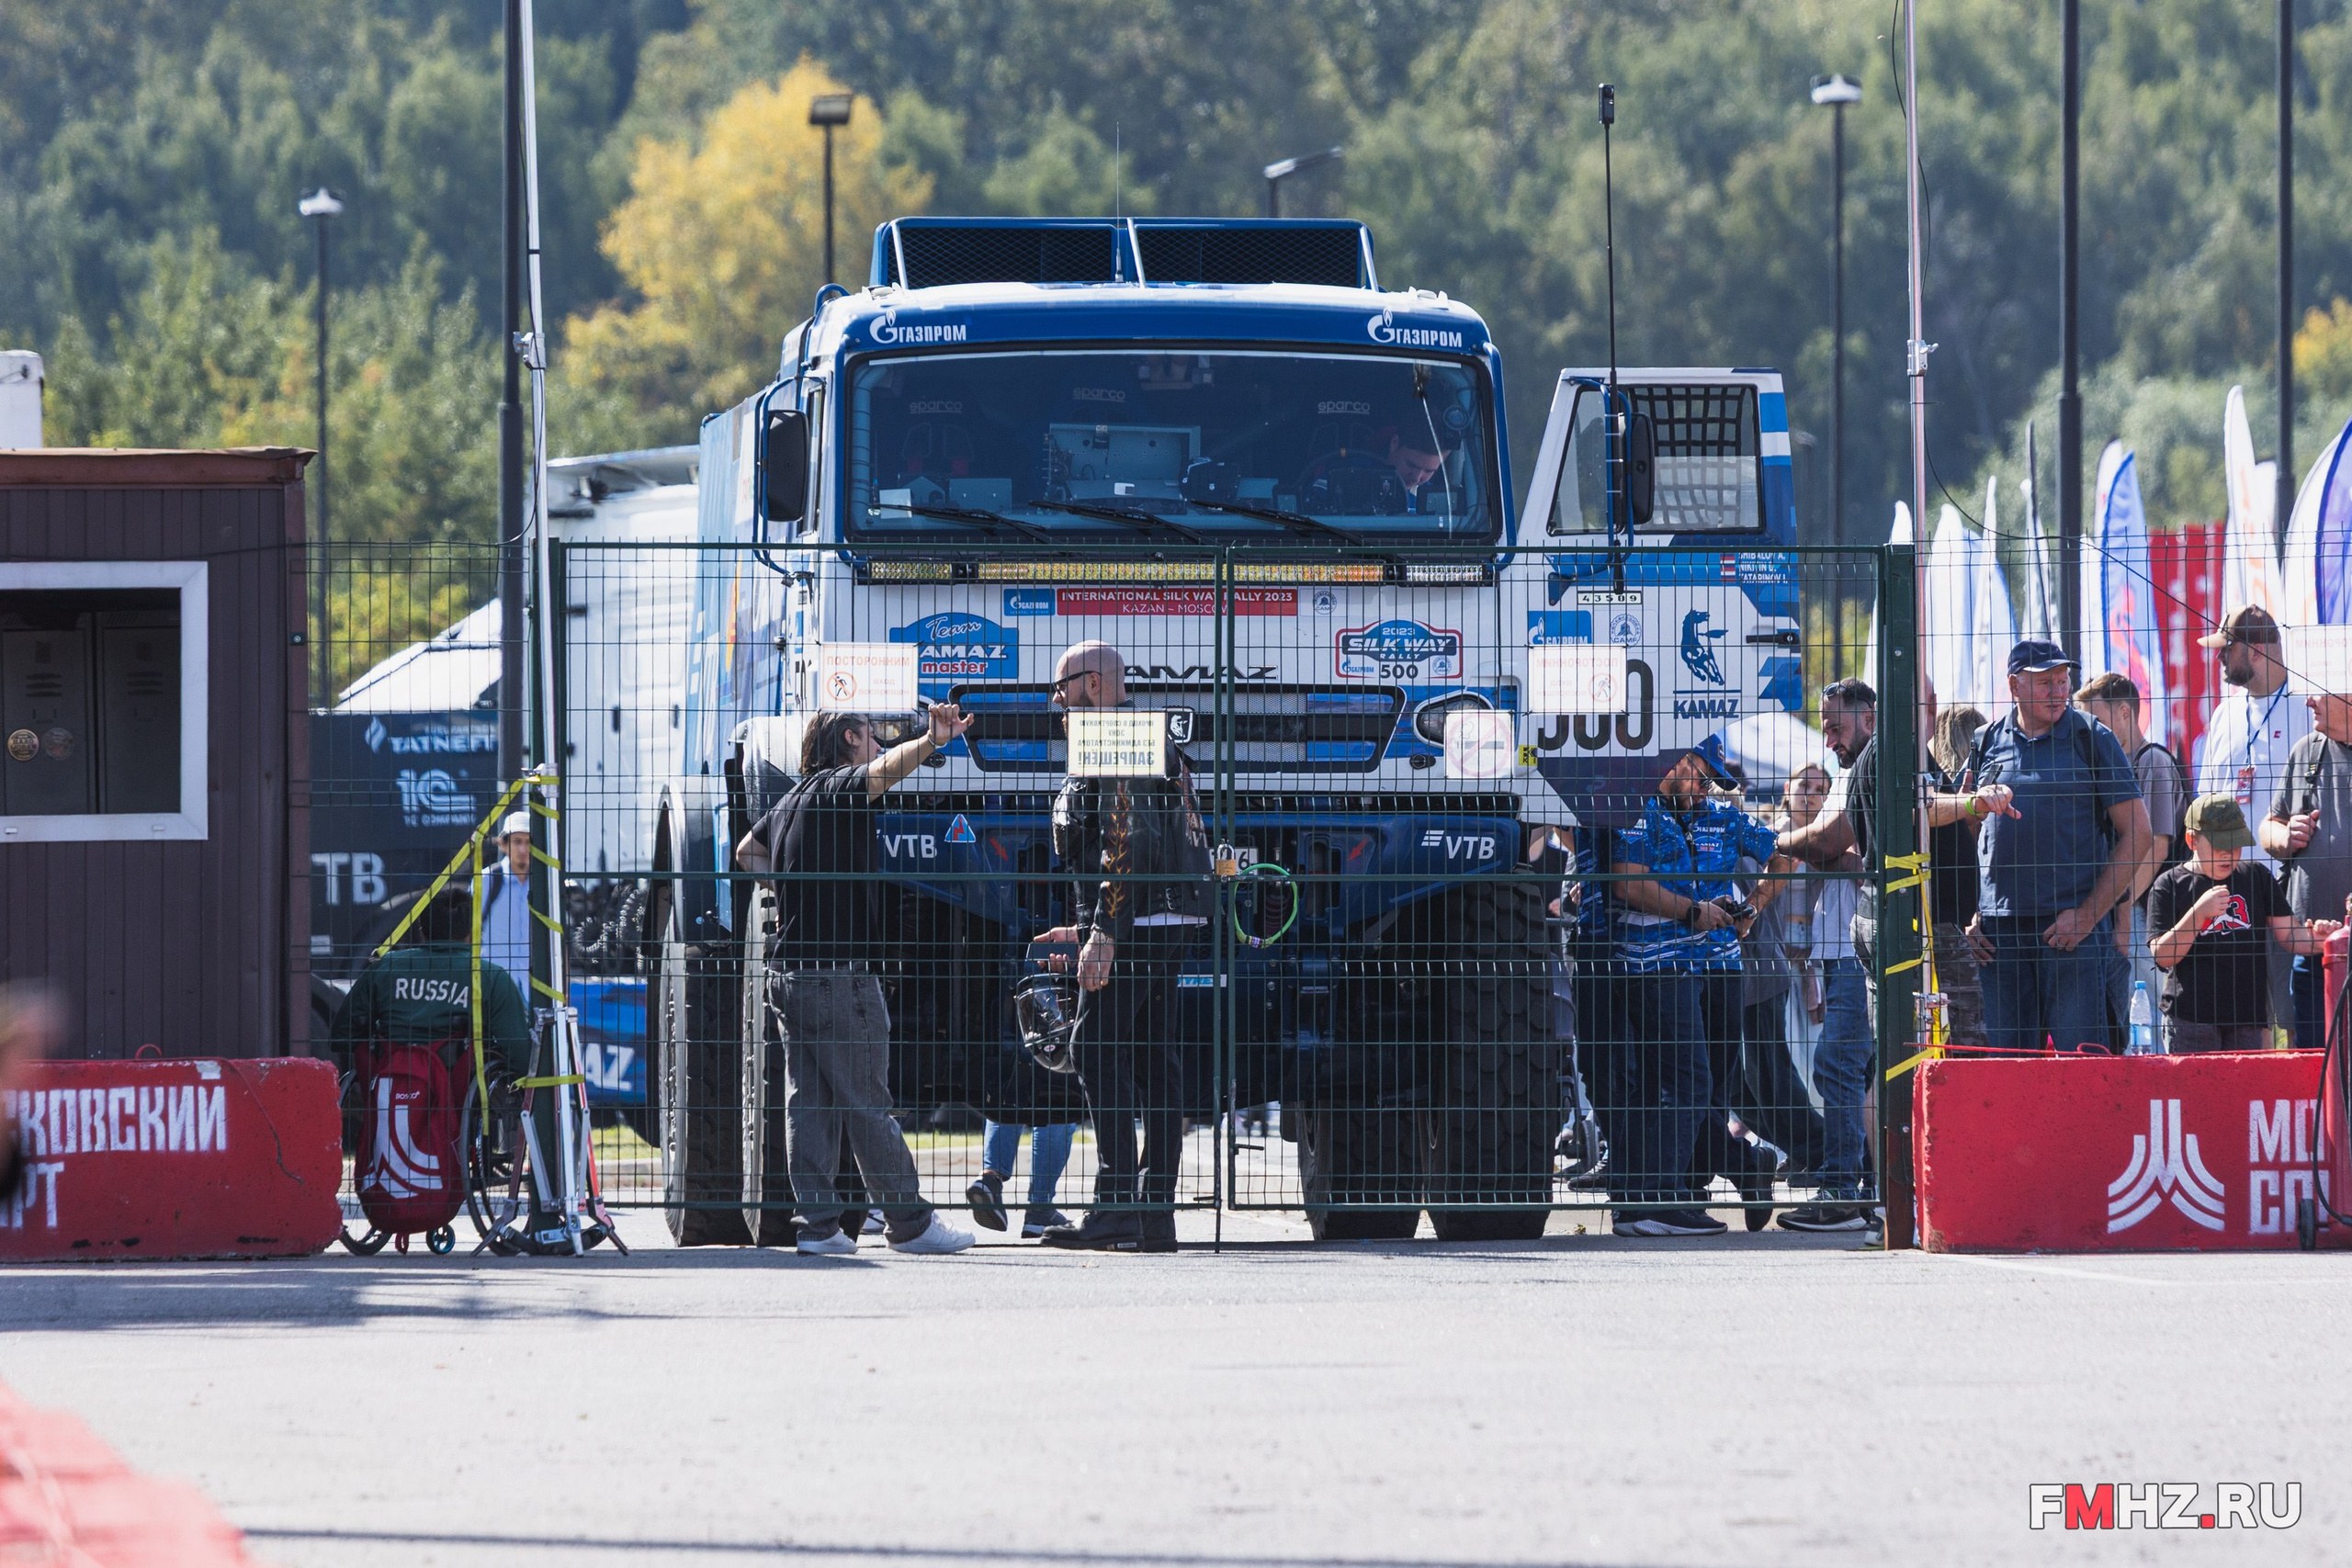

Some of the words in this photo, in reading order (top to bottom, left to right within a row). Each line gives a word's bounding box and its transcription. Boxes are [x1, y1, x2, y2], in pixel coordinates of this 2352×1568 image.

[899, 324, 967, 343] ГАЗПРОМ
[1396, 328, 1463, 347] ГАЗПРОМ
[1073, 388, 1125, 401] sparco
[910, 400, 962, 413] sparco
[1317, 401, 1370, 414] sparco
[1062, 592, 1159, 601] INTERNATIONAL
[1162, 592, 1190, 601] SILK
[1264, 592, 1293, 602] 2023
[1123, 604, 1165, 613] KAZAN
[926, 616, 981, 640] Team
[1382, 627, 1416, 636] 2023
[920, 645, 1007, 658] AMAZ
[1347, 638, 1402, 651] SILK
[1404, 638, 1452, 652] WAY
[827, 656, 910, 666] ПОСТОРОННИМ
[922, 660, 988, 674] master
[1124, 665, 1278, 680] AMAZ
[1380, 664, 1419, 679] 500
[1673, 699, 1739, 719] KAMAZ
[883, 834, 937, 858] VTB
[1445, 836, 1496, 860] VTB
[311, 852, 388, 906] TB
[395, 977, 469, 1009] RUSSIA
[2249, 1100, 2325, 1163] МО
